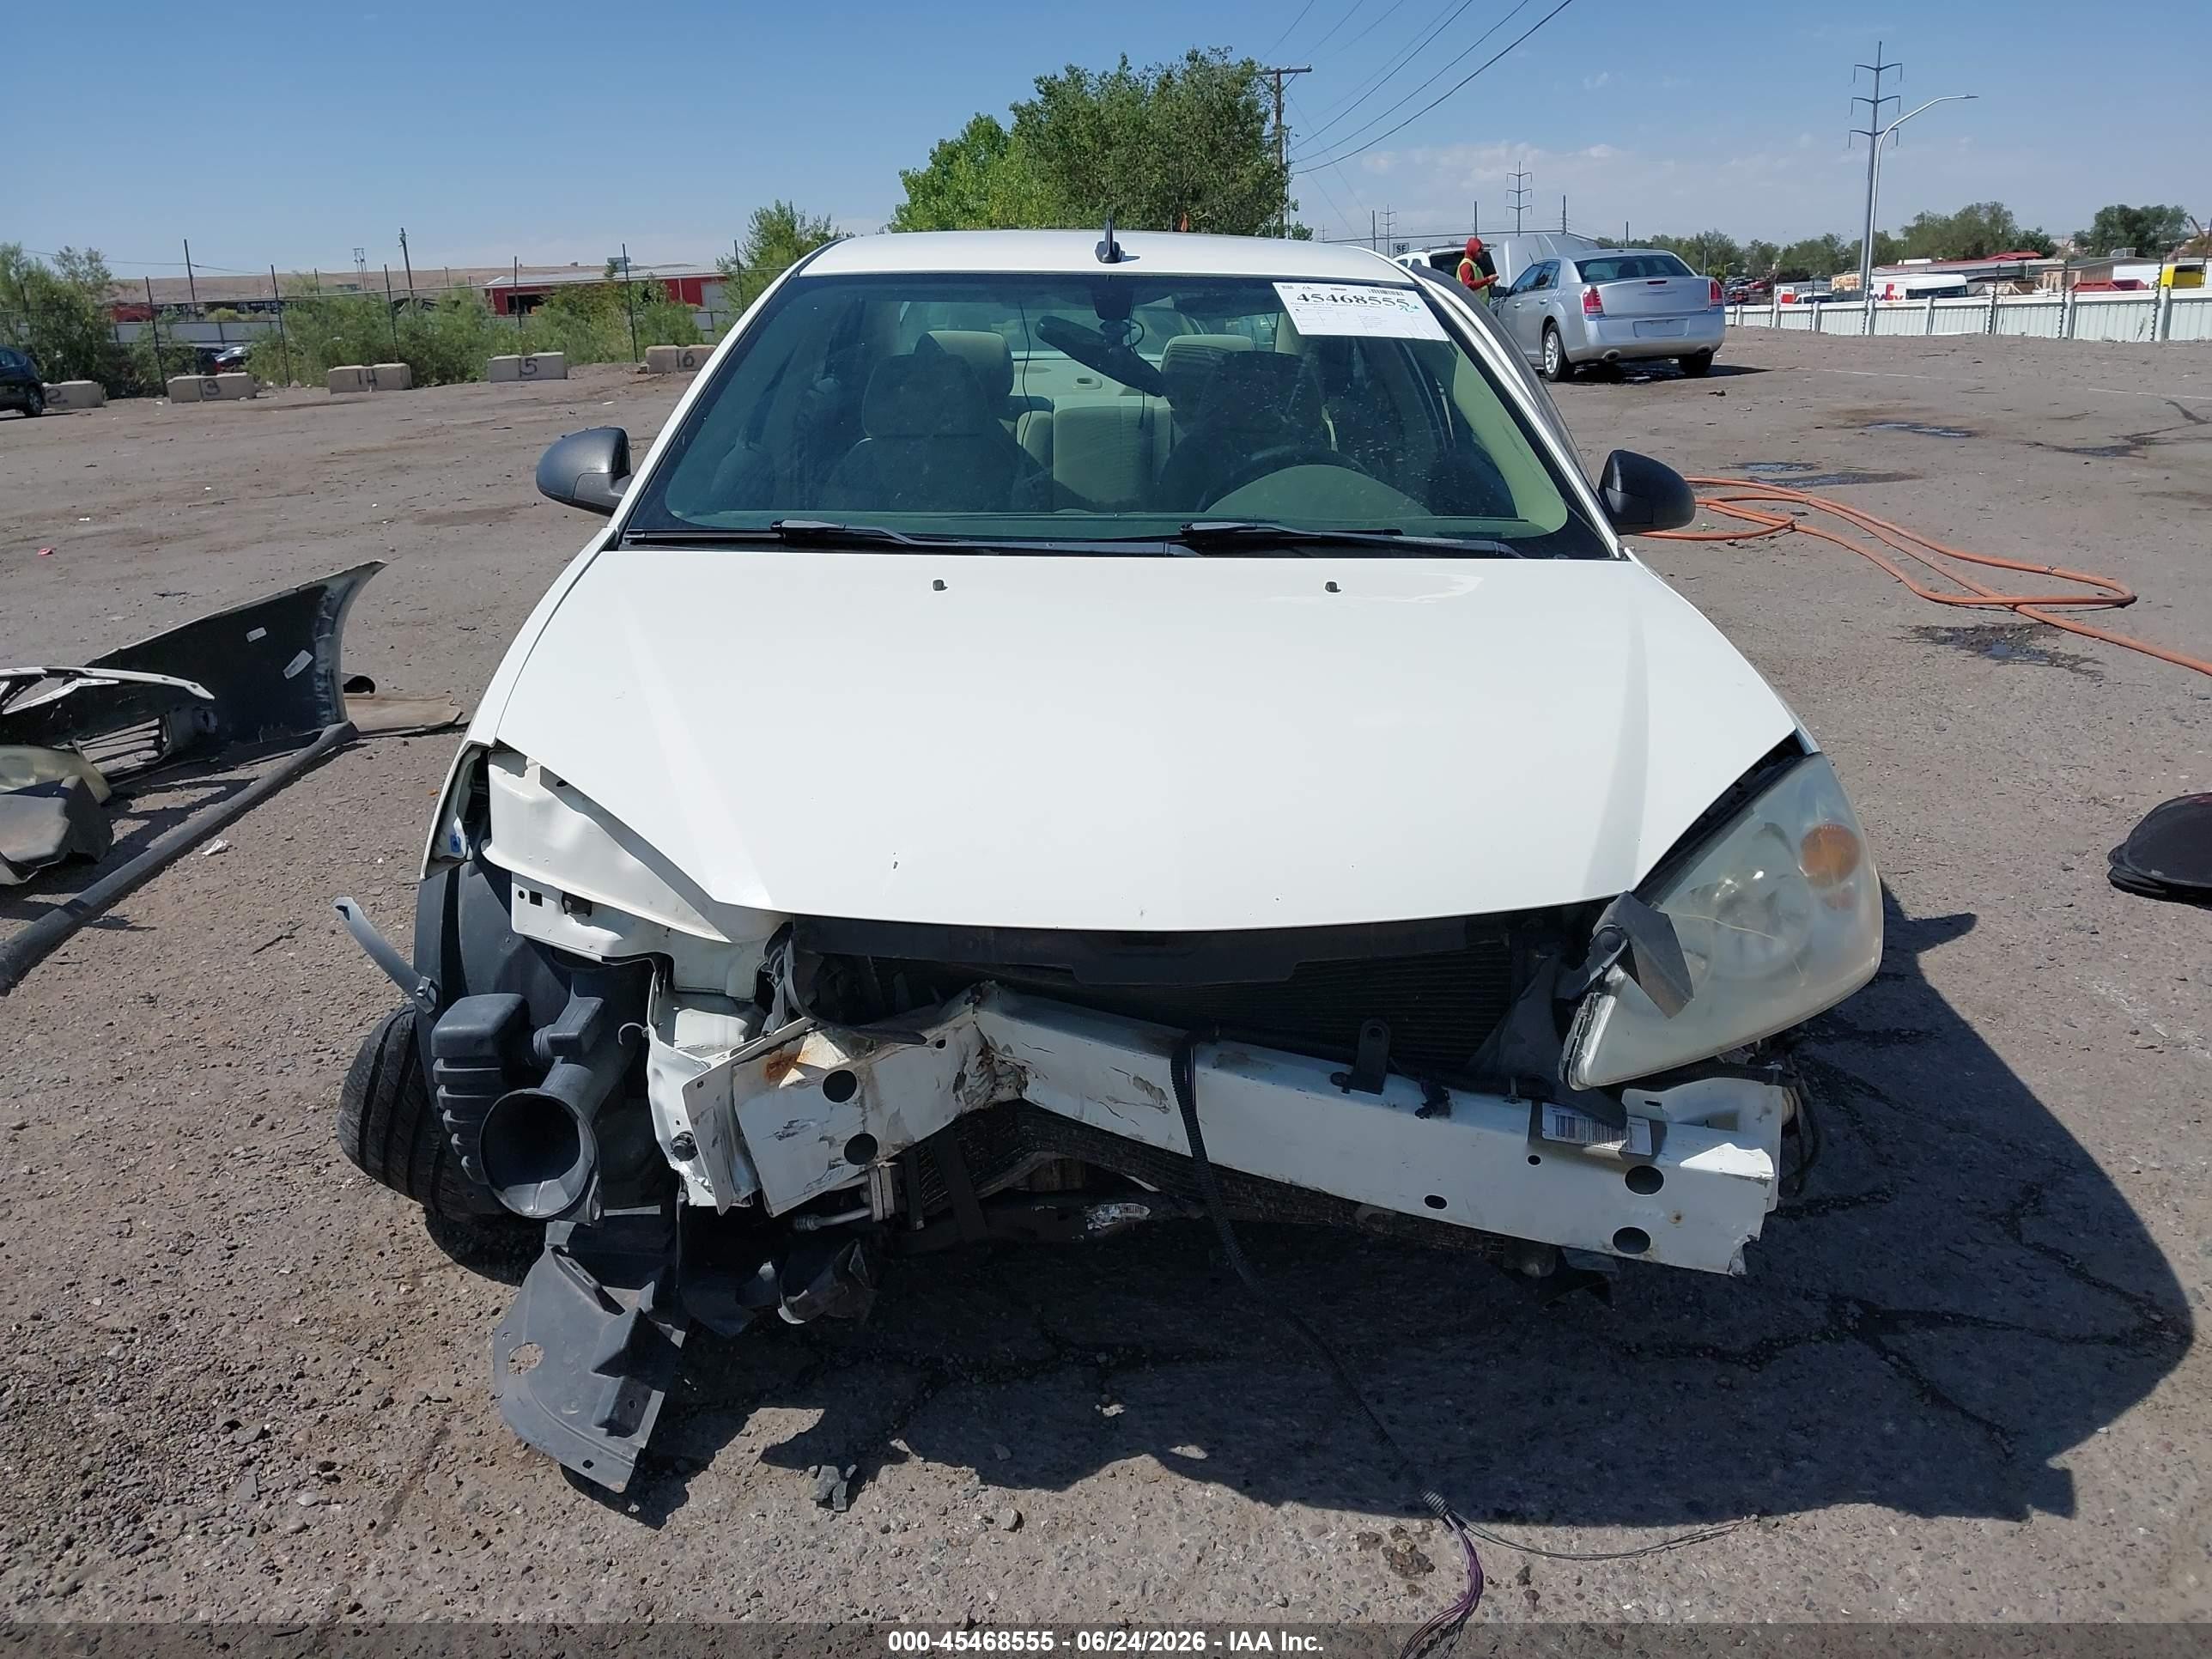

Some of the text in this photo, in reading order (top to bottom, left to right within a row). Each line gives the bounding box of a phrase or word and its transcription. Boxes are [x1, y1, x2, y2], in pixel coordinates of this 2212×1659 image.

[1297, 293, 1410, 307] 45468555
[518, 357, 538, 378] 15
[676, 349, 695, 368] 16
[356, 368, 378, 387] 14
